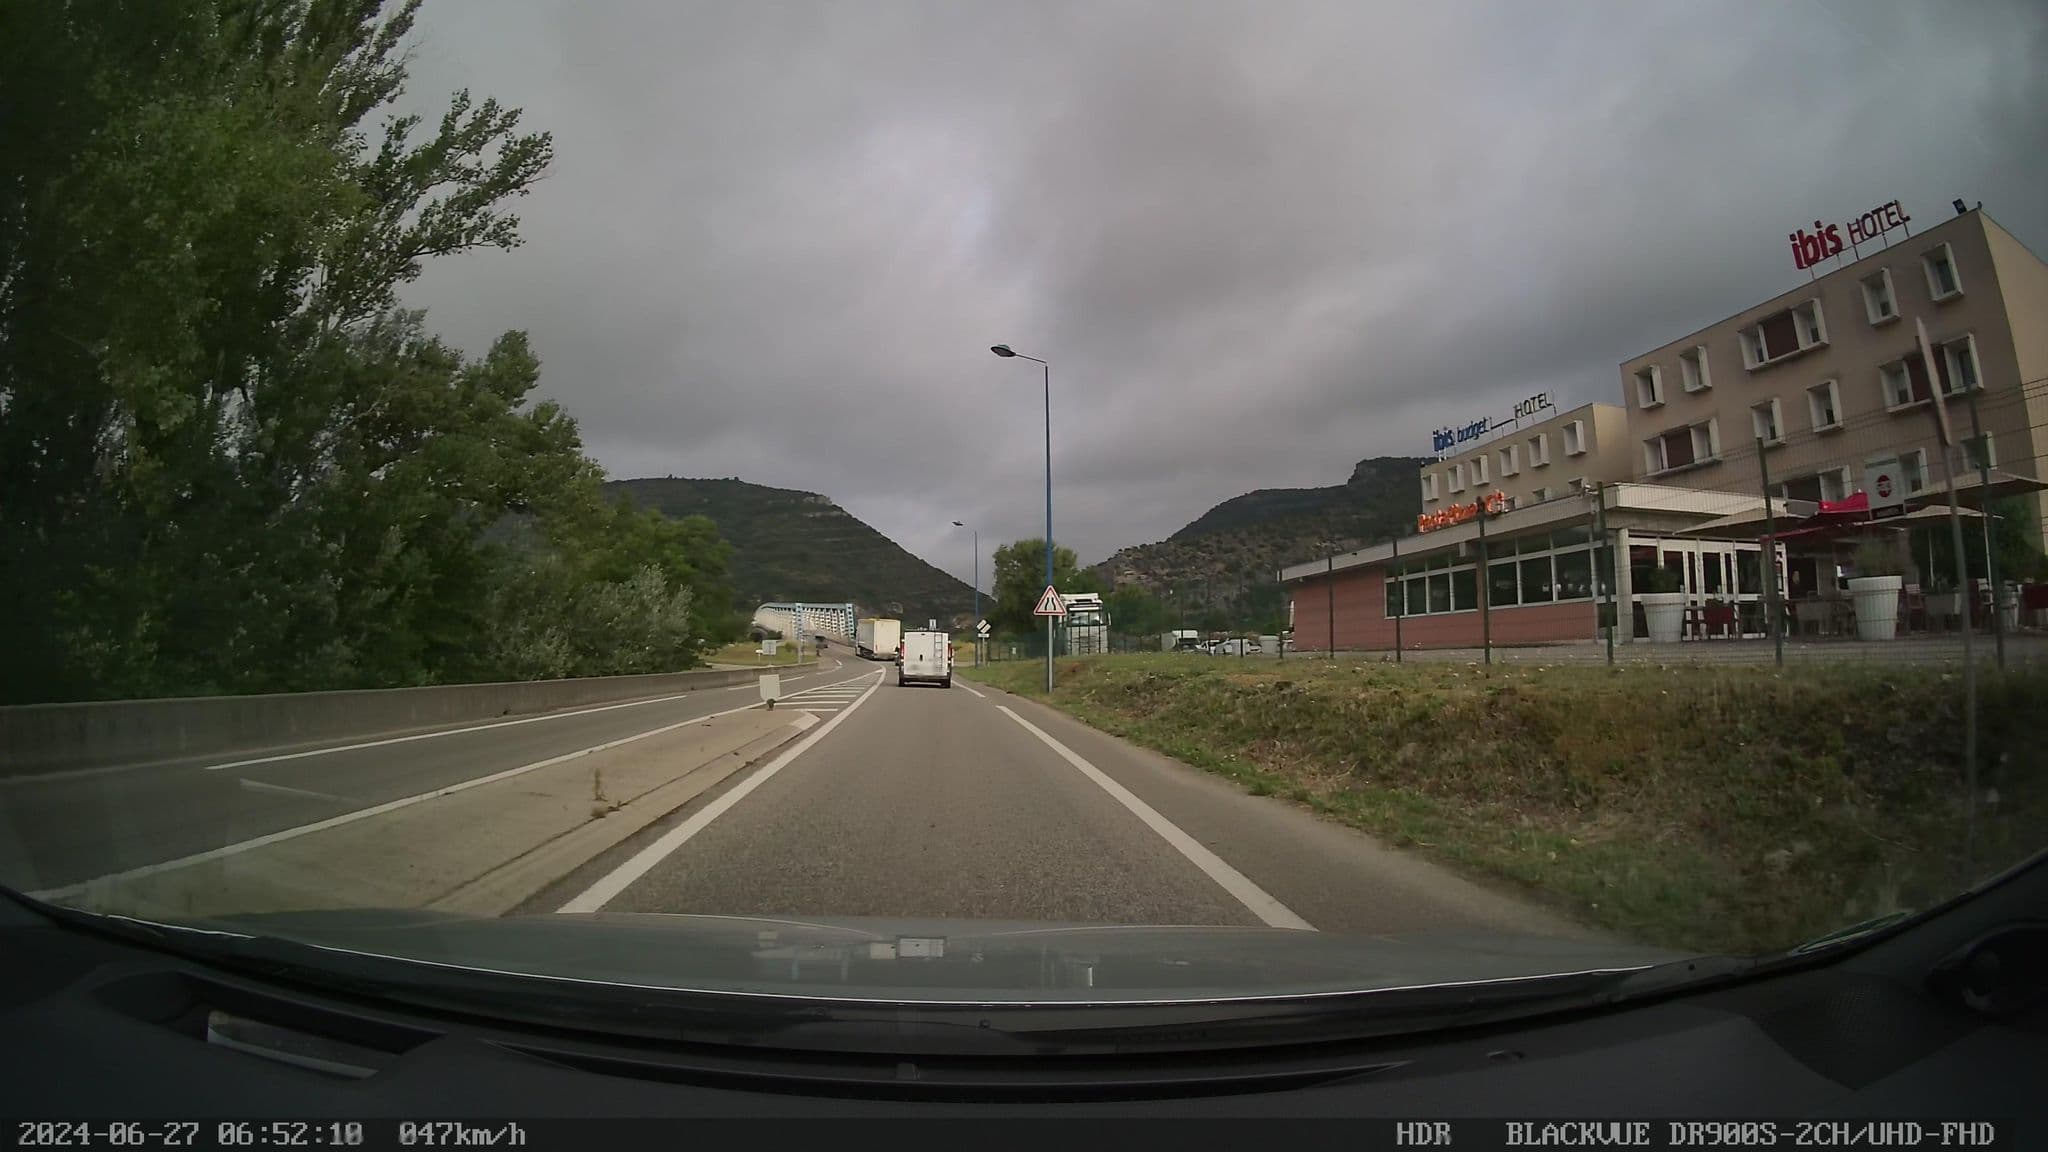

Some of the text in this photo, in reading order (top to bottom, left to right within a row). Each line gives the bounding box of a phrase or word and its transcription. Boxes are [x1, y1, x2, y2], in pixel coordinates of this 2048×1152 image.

[1790, 199, 1910, 269] ibis HOTEL
[1433, 393, 1552, 450] ibis budget HOTEL
